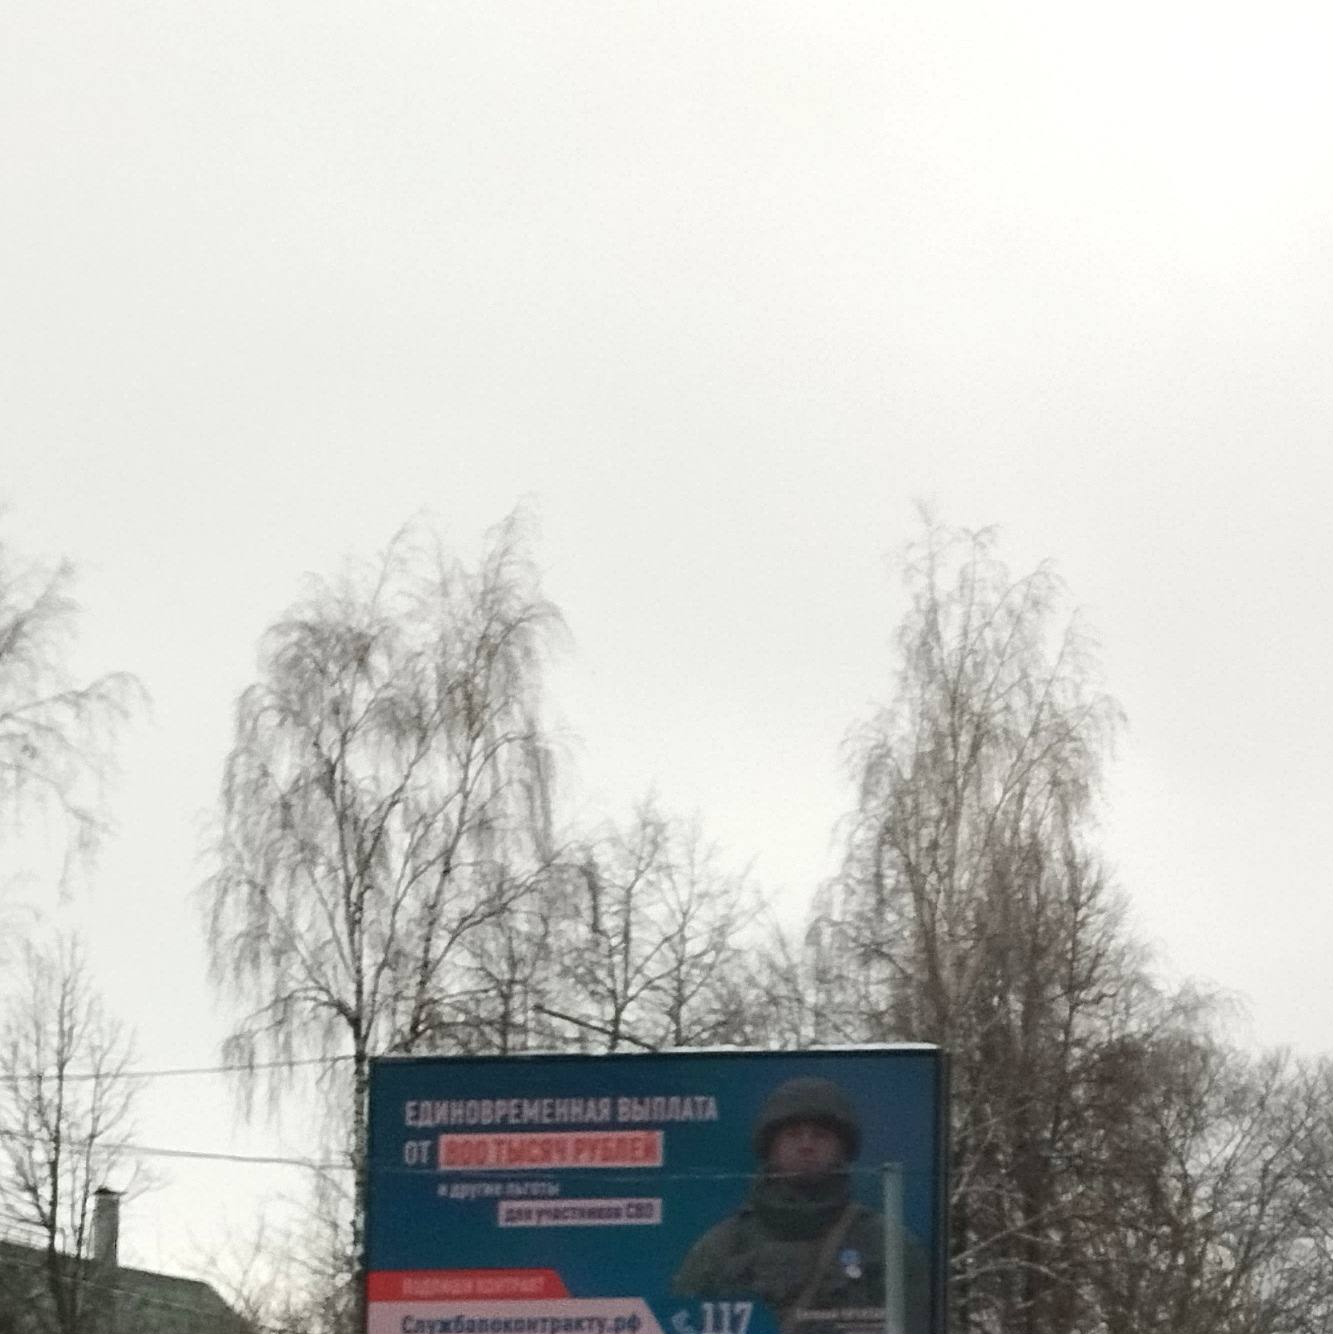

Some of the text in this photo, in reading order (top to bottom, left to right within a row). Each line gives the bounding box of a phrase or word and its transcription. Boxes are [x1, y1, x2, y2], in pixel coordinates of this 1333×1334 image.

[405, 1096, 719, 1127] ЕДИНОВРЕМЕННАЯ ВЫПЛАТА
[404, 1139, 432, 1166] ОТ
[626, 1202, 654, 1219] СВО
